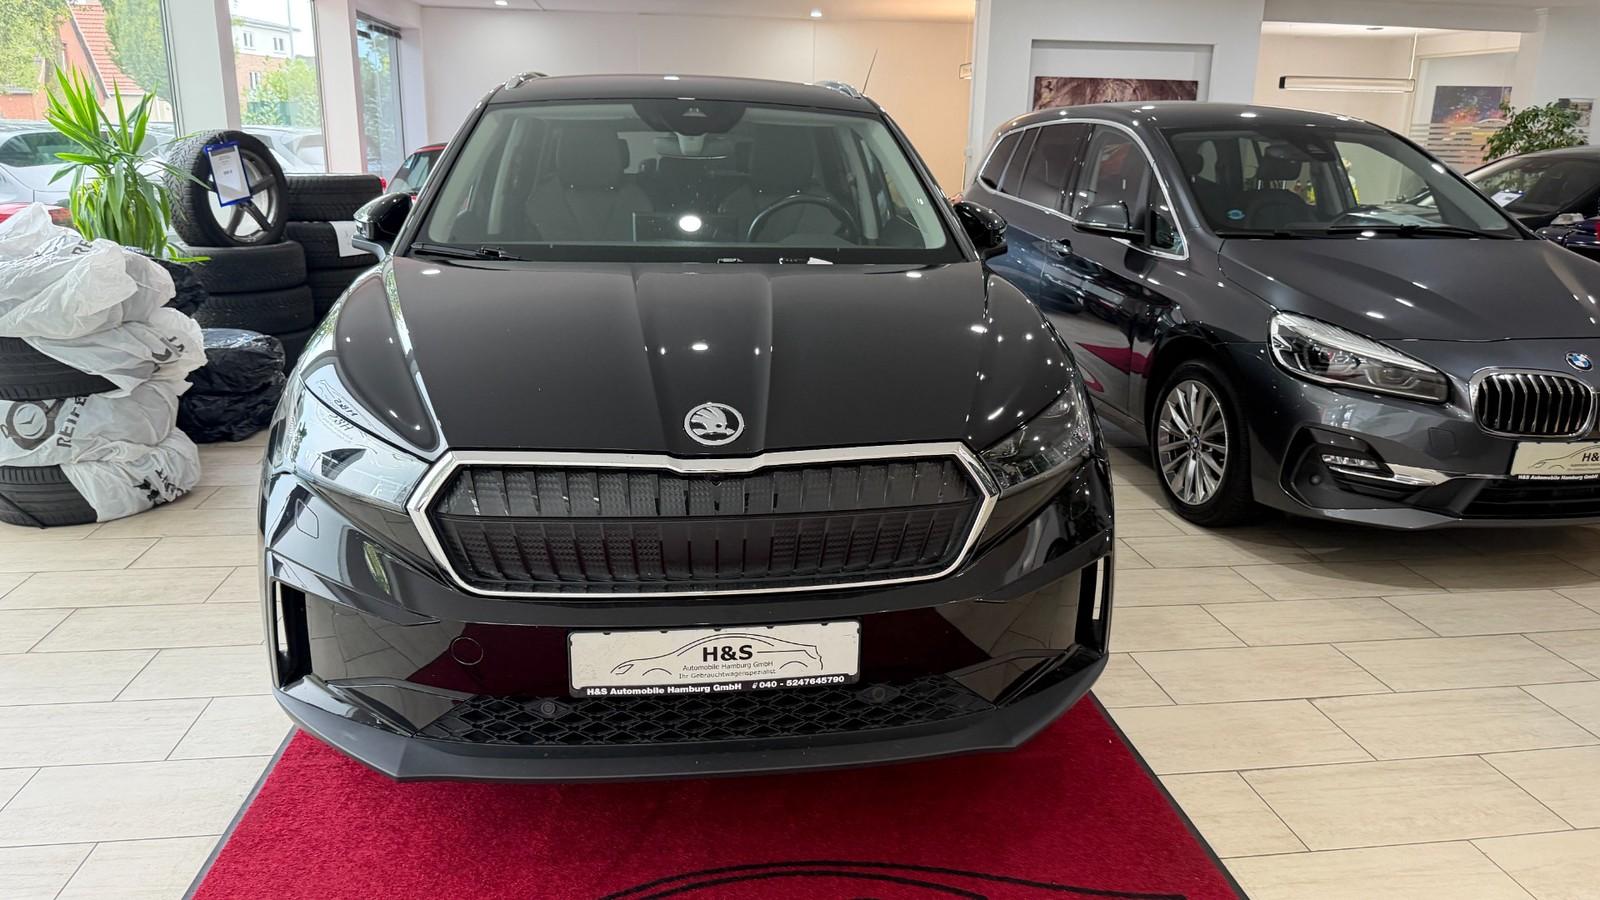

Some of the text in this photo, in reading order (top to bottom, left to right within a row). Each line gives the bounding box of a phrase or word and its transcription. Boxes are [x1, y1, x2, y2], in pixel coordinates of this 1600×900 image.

[702, 644, 753, 662] H&S
[682, 660, 774, 671] Automobile Hamburg GmbH
[690, 668, 776, 679] Gebrauchtwagenspezialist
[586, 688, 608, 696] H&S
[609, 686, 665, 696] Automobile
[667, 684, 711, 694] Hamburg
[713, 683, 742, 692] GmbH
[759, 680, 777, 689] 040
[786, 675, 845, 687] 5247645790
